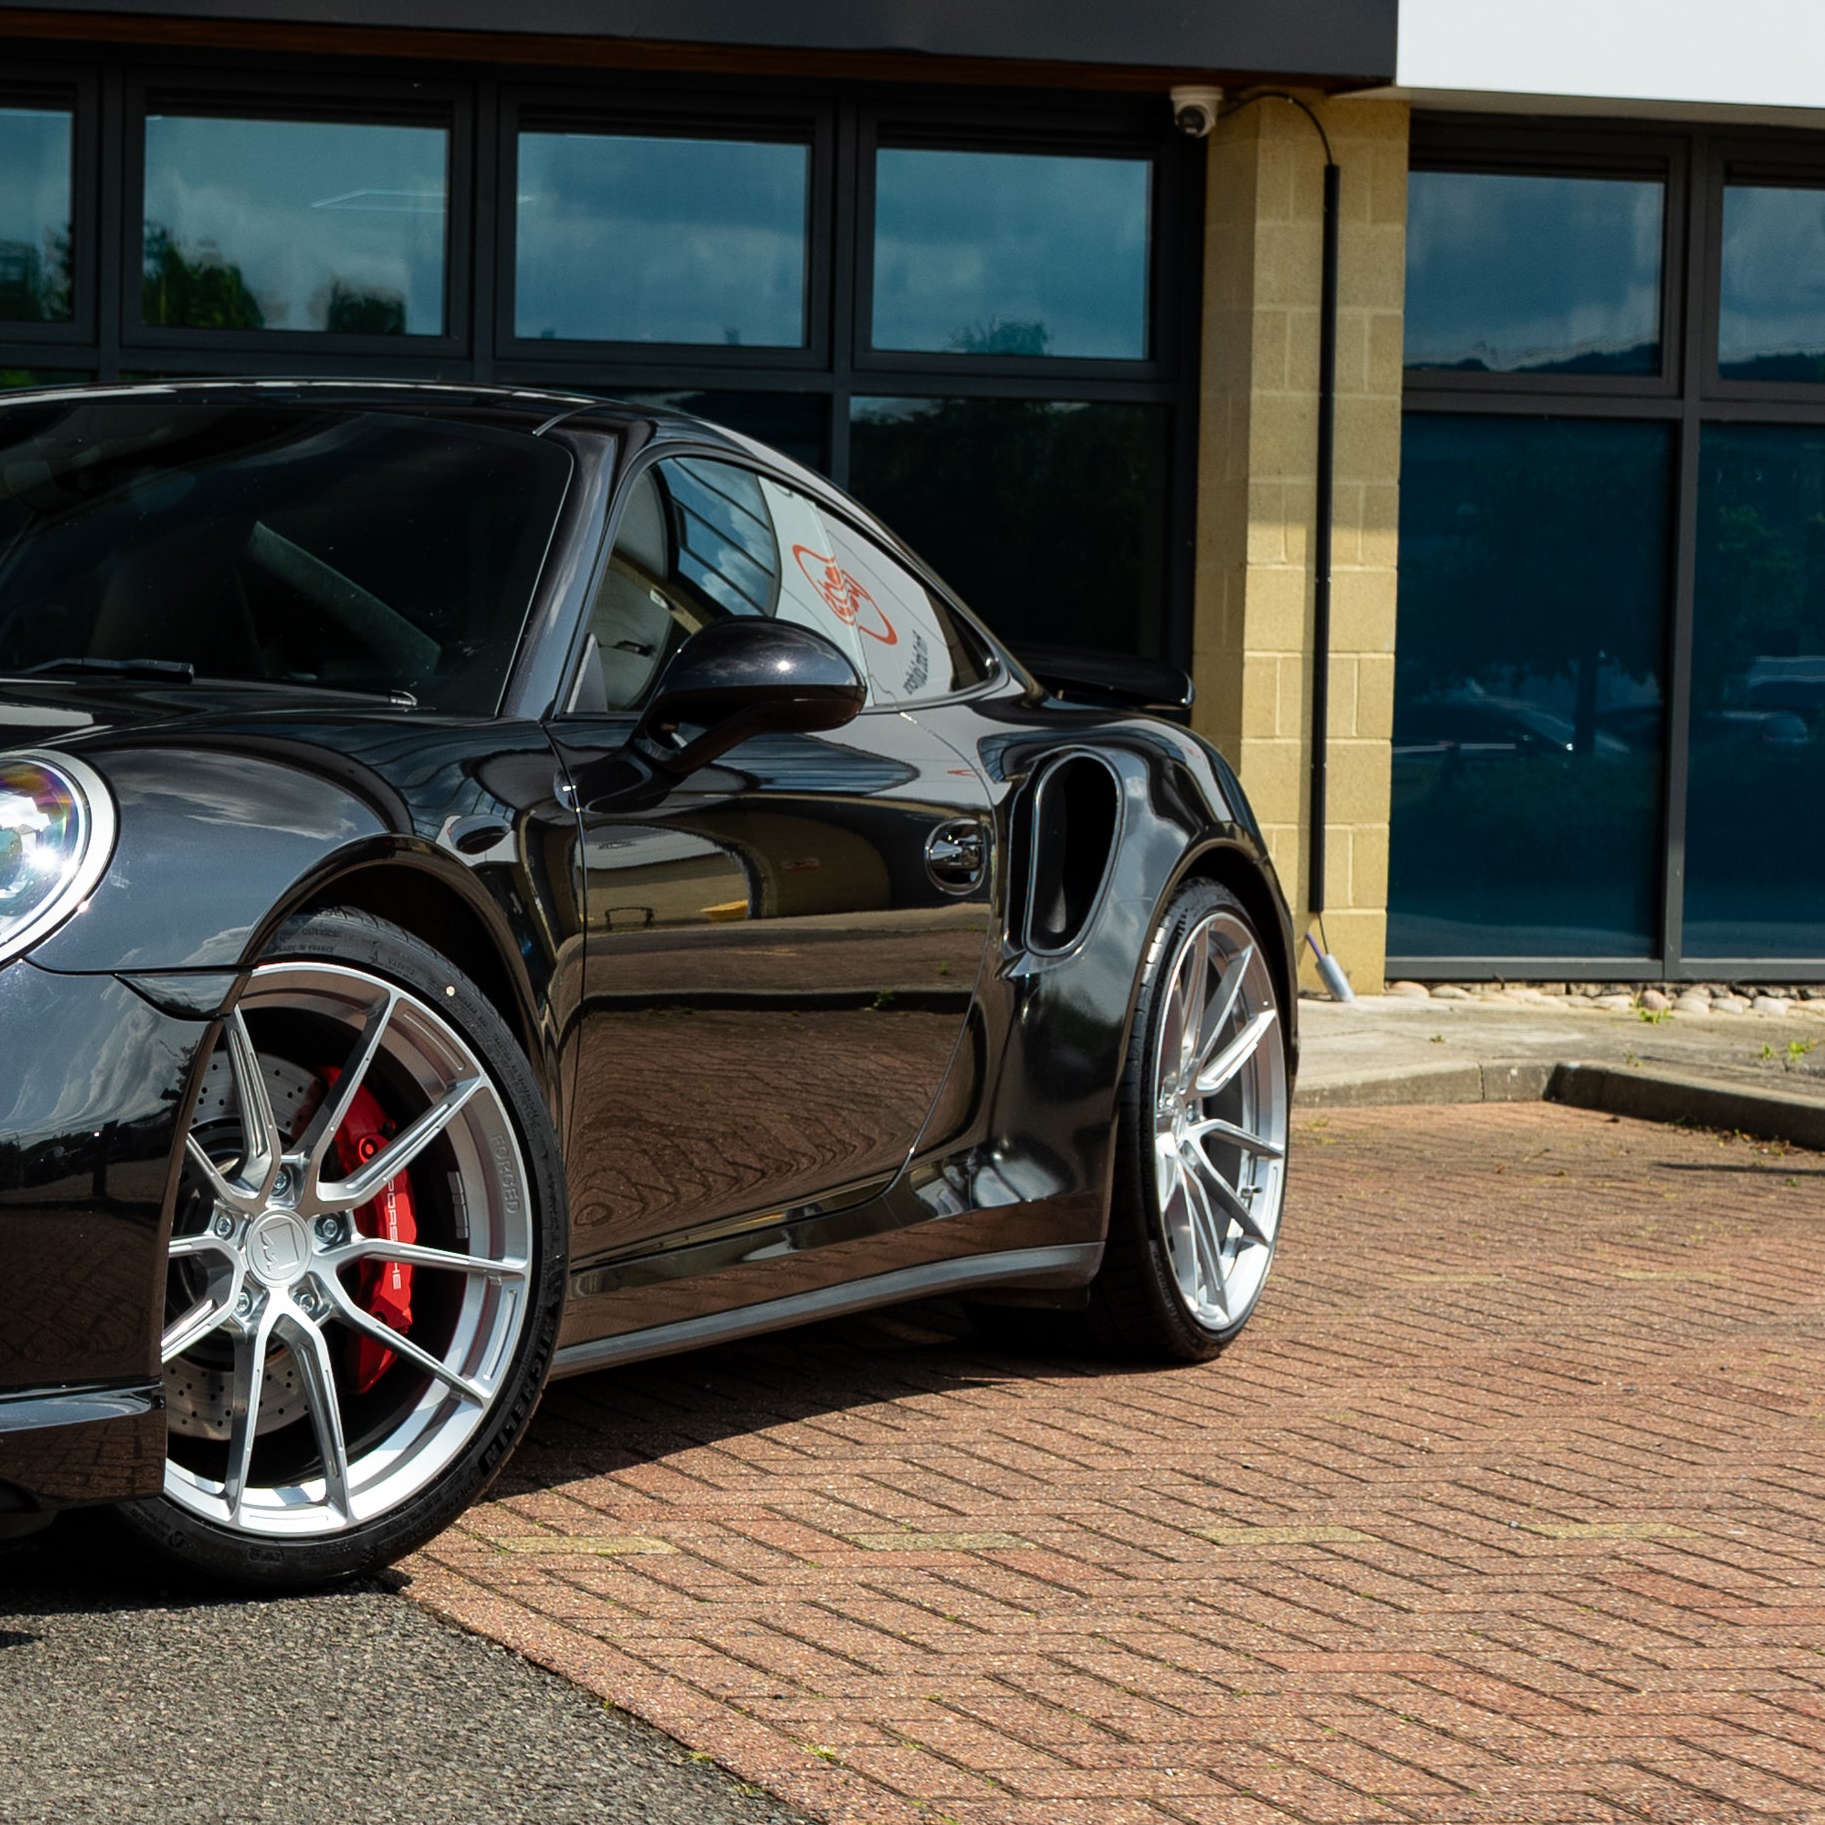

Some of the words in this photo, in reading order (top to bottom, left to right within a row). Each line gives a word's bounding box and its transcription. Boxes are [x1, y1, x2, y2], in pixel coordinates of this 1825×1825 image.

[486, 1133, 521, 1215] FORGED
[387, 1178, 401, 1289] PORSHE
[479, 1316, 558, 1467] MICHELIN
